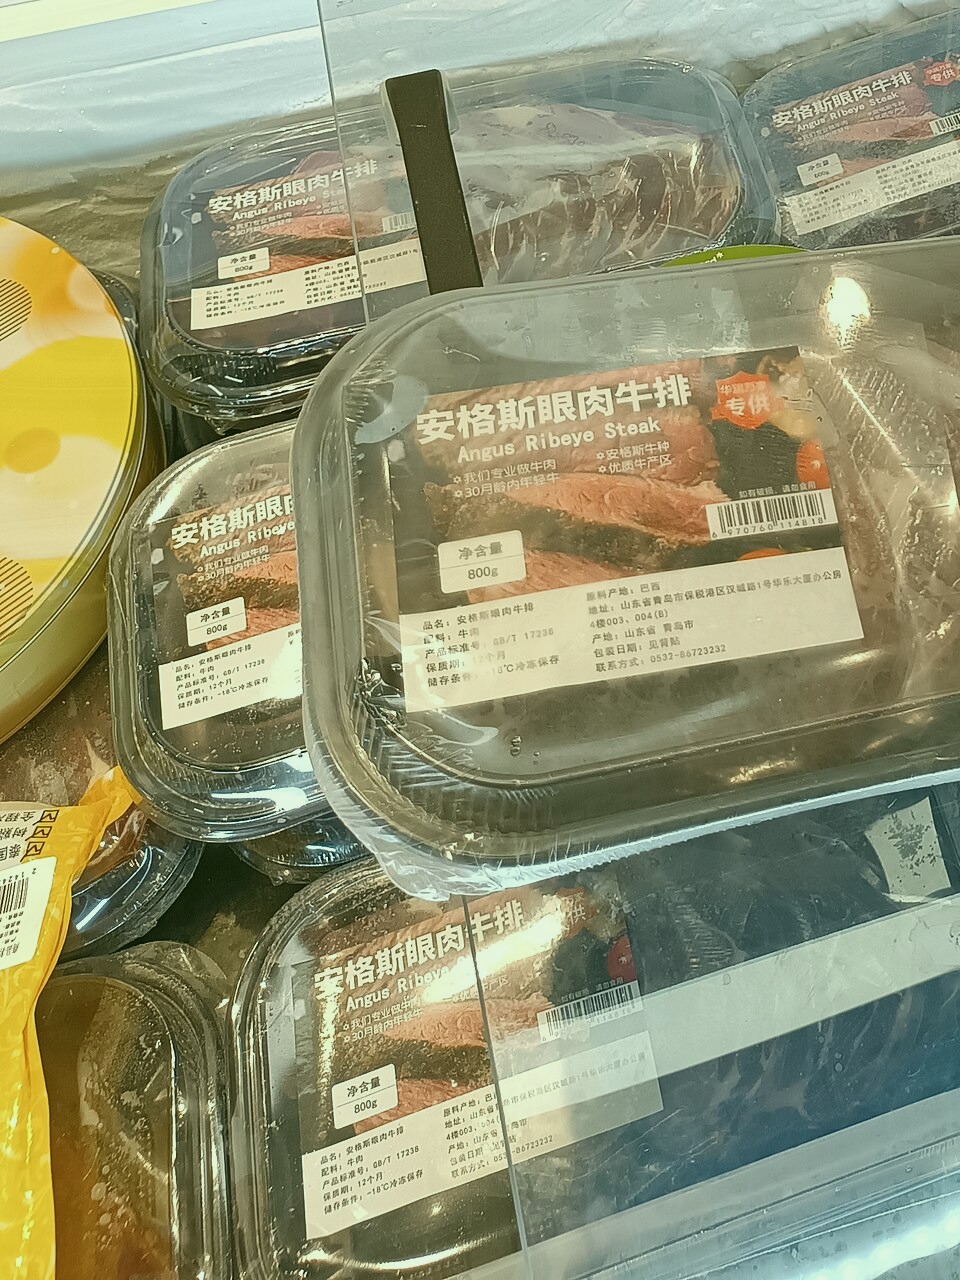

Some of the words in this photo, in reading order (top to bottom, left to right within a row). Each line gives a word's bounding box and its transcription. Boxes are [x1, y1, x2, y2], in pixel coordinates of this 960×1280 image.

[772, 70, 912, 128] 安格斯眼肉牛排
[869, 91, 899, 108] Steak
[232, 207, 269, 222] Angus
[416, 374, 693, 446] 安格斯眼肉牛排
[725, 394, 771, 417] 专供
[457, 442, 516, 464] Angus
[525, 428, 595, 452] Ribeye
[605, 417, 662, 440] Steak
[605, 440, 671, 461] 安格斯牛种
[463, 458, 557, 485] 我们专业做牛肉
[607, 453, 673, 475] 优质牛产区
[464, 472, 560, 499] 30月龄内年轻牛
[200, 538, 241, 559] Angus
[458, 541, 503, 561] 净含量
[467, 566, 499, 581] 800g
[200, 606, 231, 623] 净含量
[206, 623, 228, 636] 800g
[313, 899, 524, 1001] 安格斯眼肉牛排
[345, 989, 390, 1013] Angus
[346, 1075, 382, 1099] 净含量
[353, 1098, 378, 1115] 800g
[396, 1145, 420, 1161] 17238
